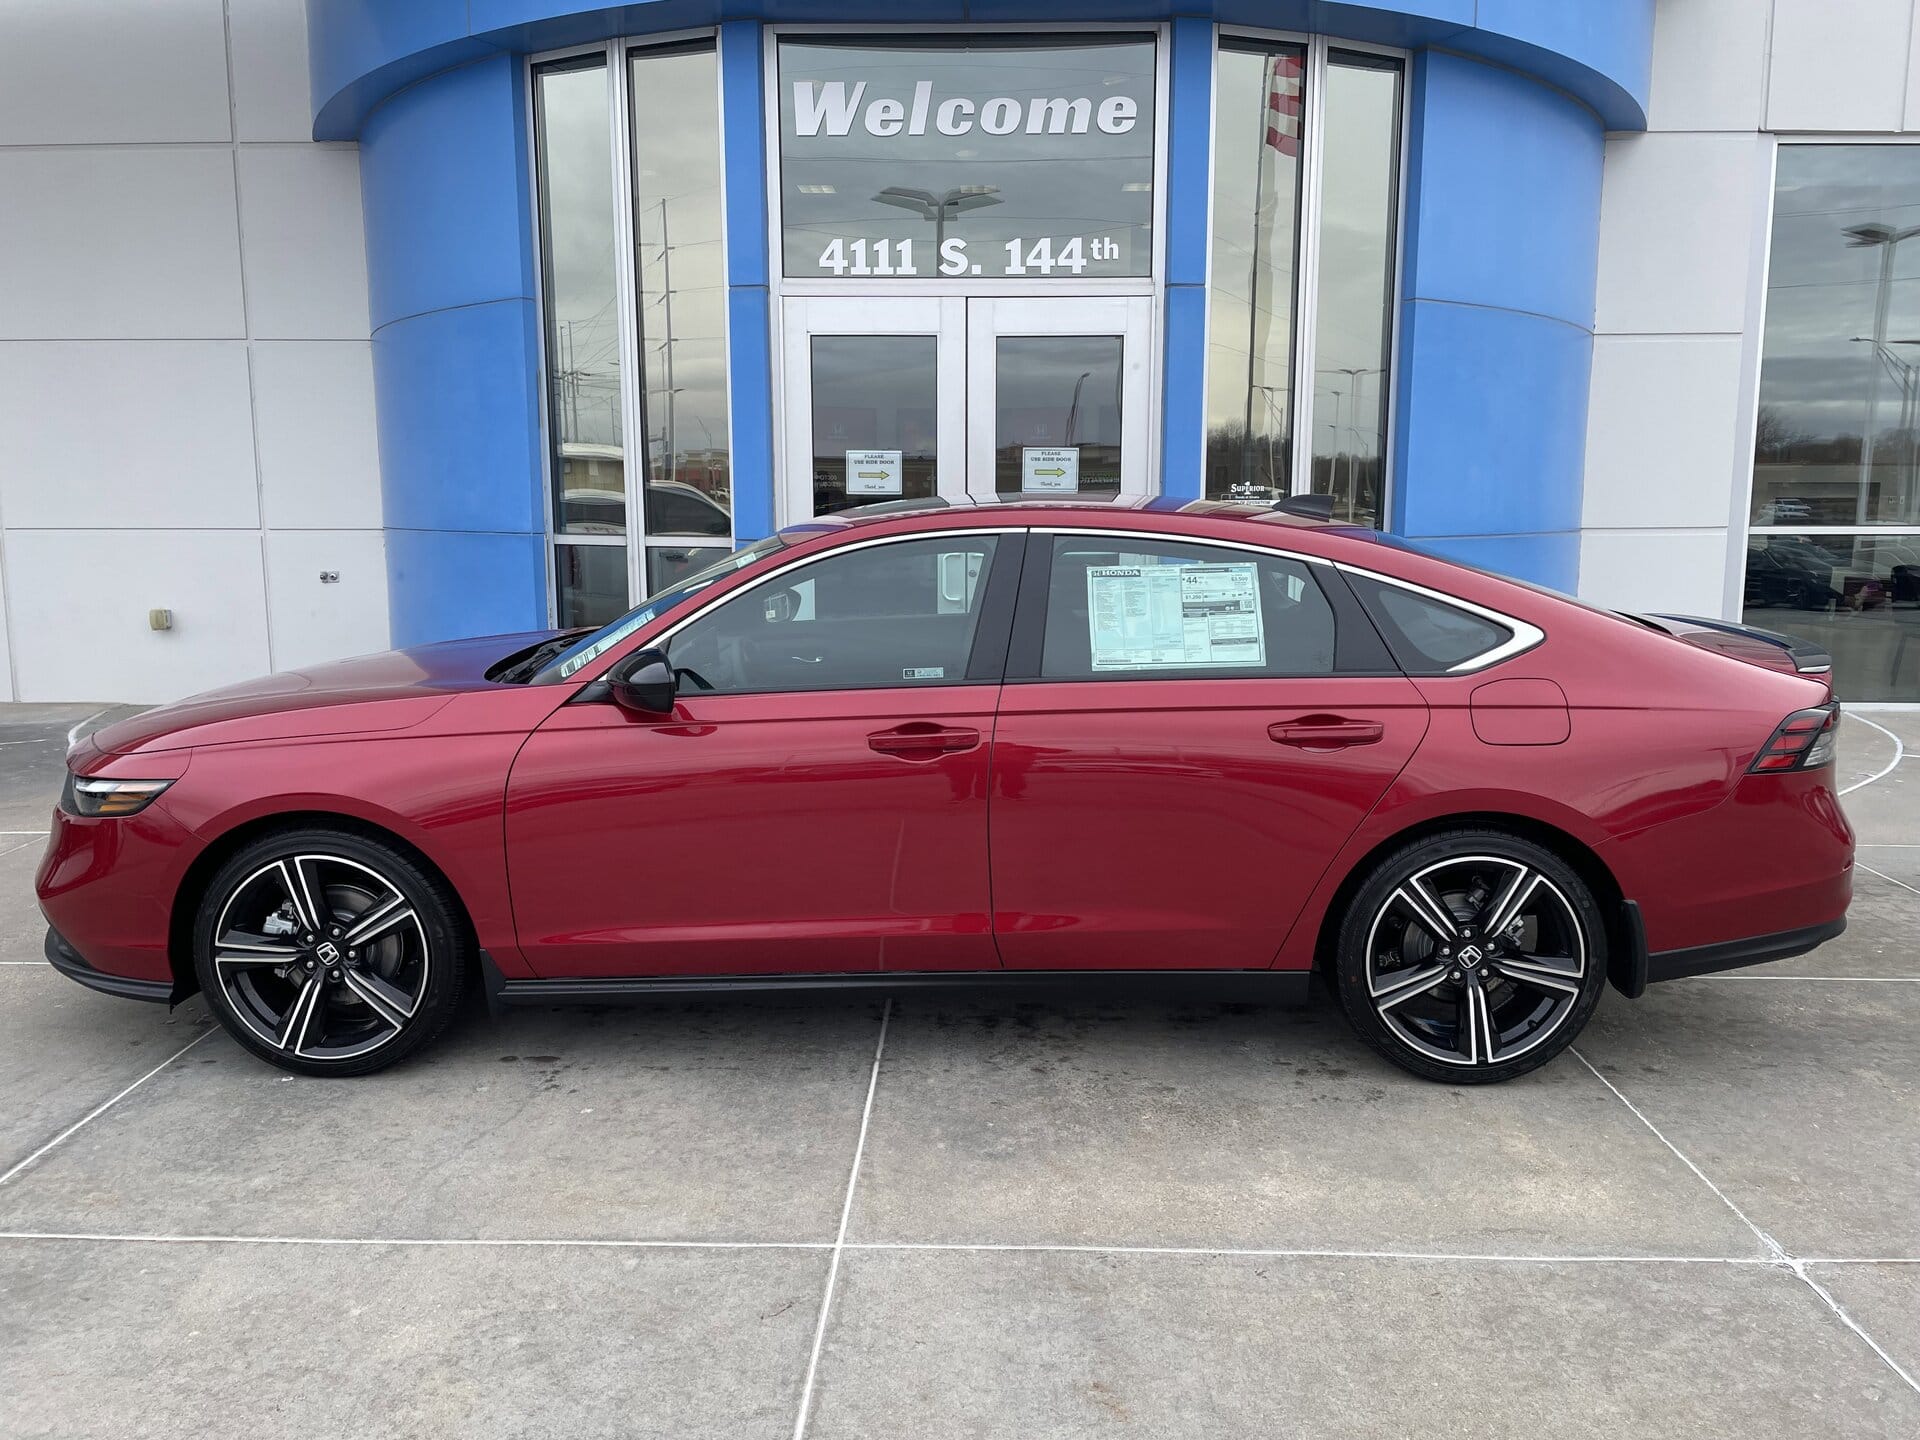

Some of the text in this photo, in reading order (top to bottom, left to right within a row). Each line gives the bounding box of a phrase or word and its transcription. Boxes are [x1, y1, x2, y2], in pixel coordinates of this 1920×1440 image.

[793, 80, 1138, 137] Welcome
[818, 237, 1119, 275] 4111 S. 144th
[1186, 576, 1198, 584] 44
